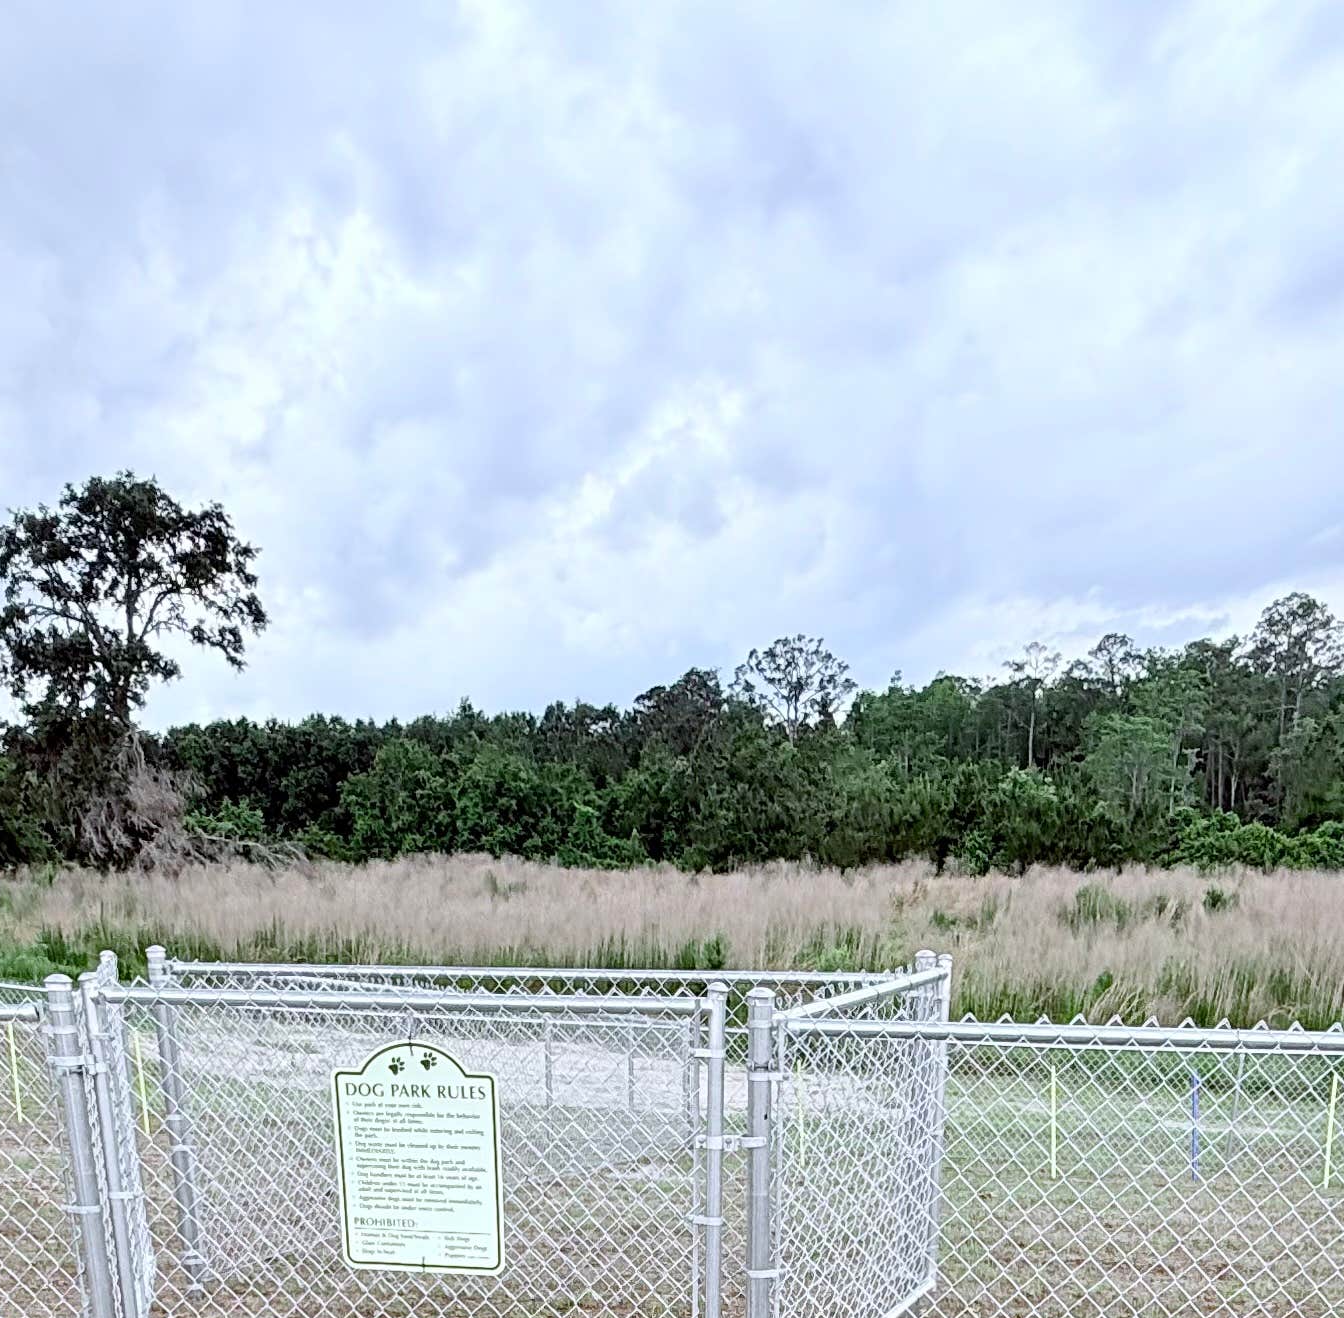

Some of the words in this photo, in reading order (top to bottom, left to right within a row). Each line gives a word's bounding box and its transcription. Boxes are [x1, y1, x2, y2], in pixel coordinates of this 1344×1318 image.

[345, 1082, 385, 1097] DOG
[391, 1083, 431, 1098] PARK
[437, 1085, 486, 1100] RULES
[353, 1217, 419, 1228] PROHIBITED:
